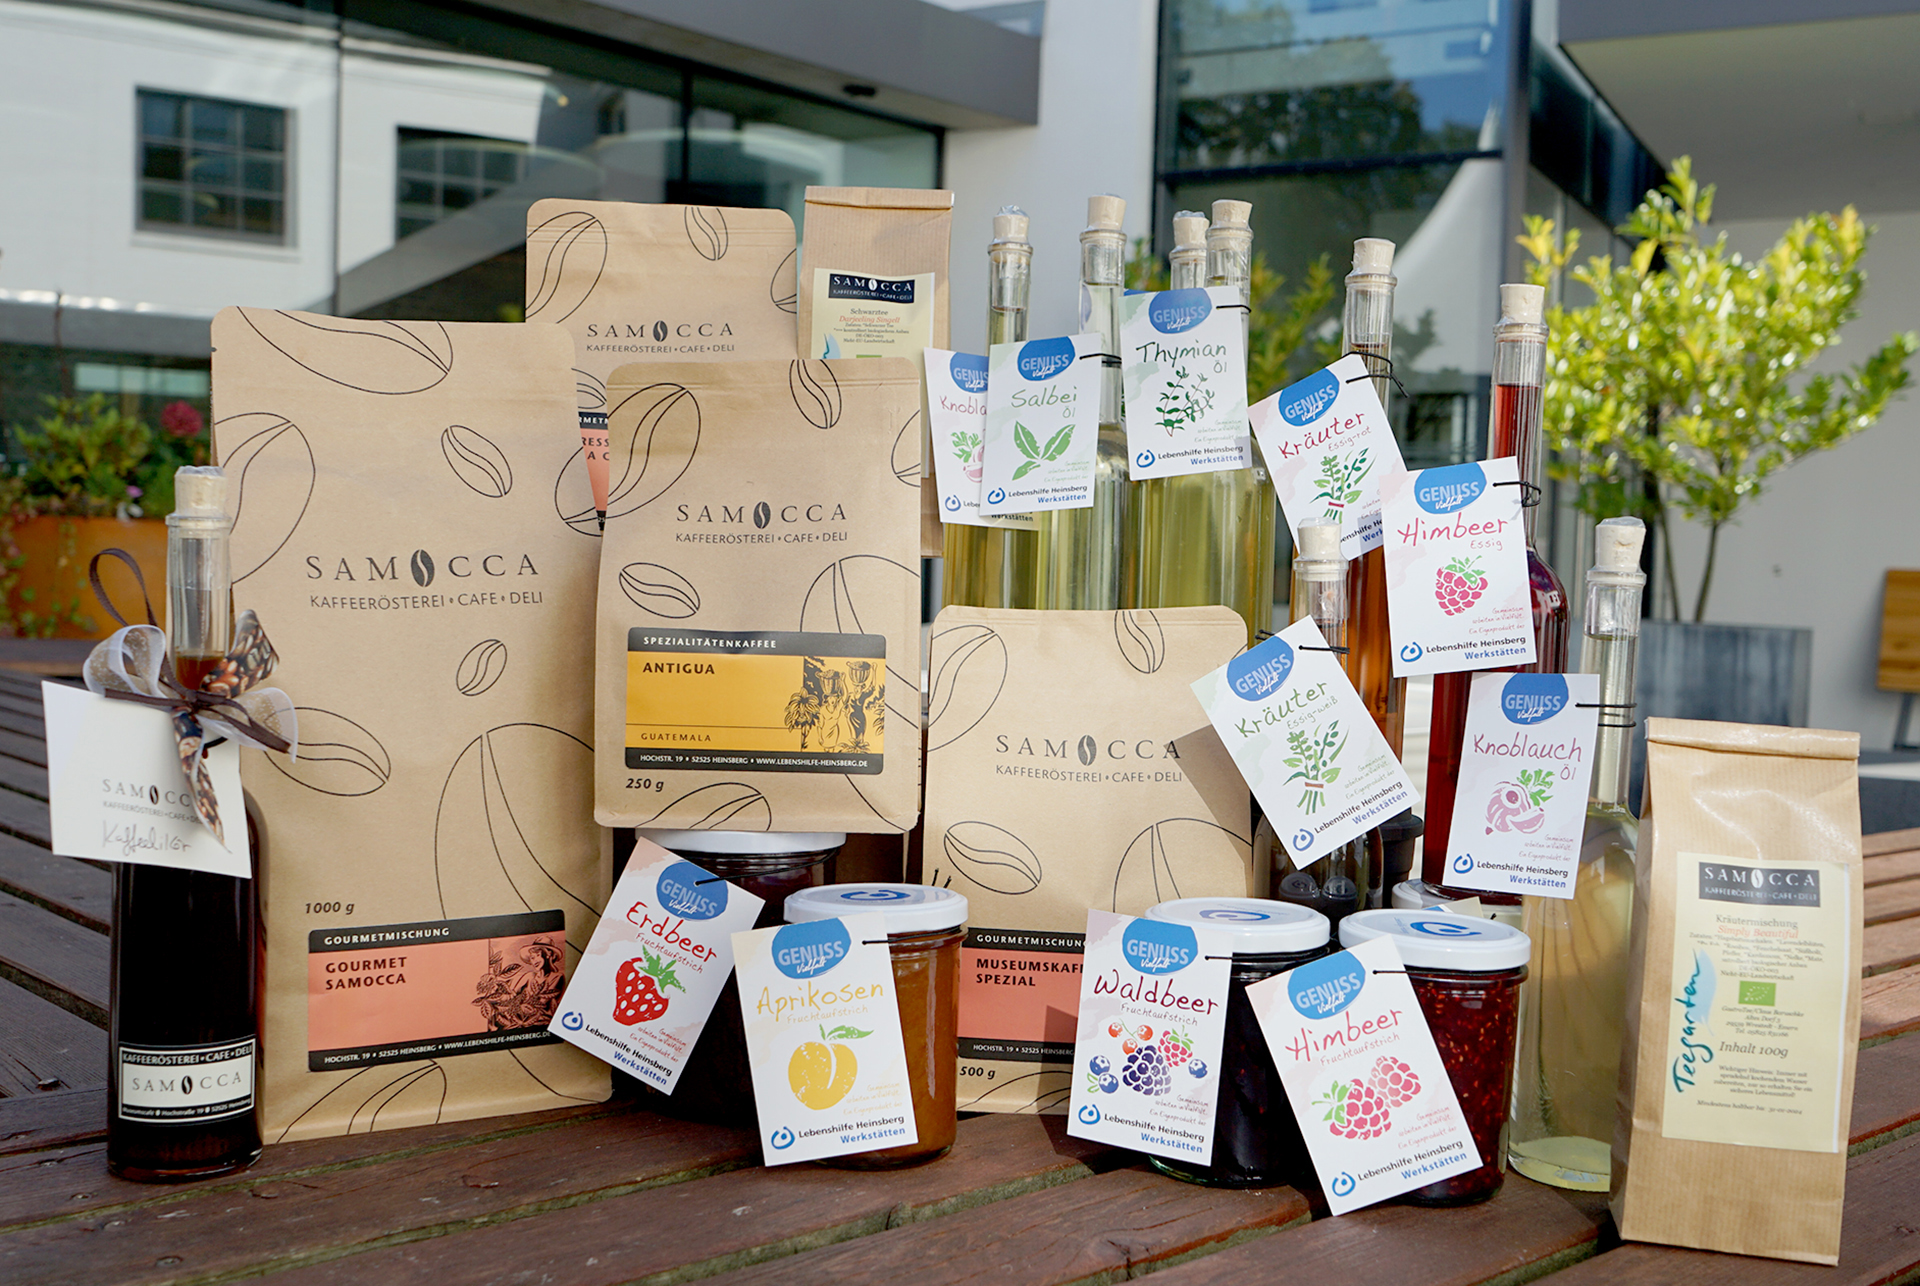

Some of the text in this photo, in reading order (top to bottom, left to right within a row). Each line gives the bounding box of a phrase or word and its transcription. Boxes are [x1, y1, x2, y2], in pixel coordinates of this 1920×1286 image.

[850, 308, 888, 316] Schwarztee
[1153, 306, 1206, 325] GENUSS
[586, 344, 735, 354] KAFFEERÖSTEREI CAFE DELI
[1136, 339, 1227, 368] Thymian
[1021, 354, 1069, 372] GENUSS
[1213, 362, 1228, 378] Öl
[953, 368, 987, 383] GENUS
[1011, 385, 1077, 408] Salbei
[1284, 384, 1337, 420] GENUSS
[1062, 407, 1076, 419] Öl
[1277, 412, 1366, 458] Kräuter
[1158, 445, 1244, 463] Lebenshilfe Heinsberg
[1190, 454, 1244, 467] Werkstätten
[1008, 485, 1088, 499] Lebenshilfe Heinsberg
[1037, 494, 1087, 504] Werkstätten
[1419, 481, 1480, 503] GENUSS
[676, 532, 848, 544] KAFFEERÖSTEREI CAFE DELI
[1397, 512, 1508, 547] Himbeer
[1470, 539, 1503, 552] Essig
[310, 591, 544, 611] KAFFEERÖSTEREI CAFE DELI
[643, 635, 777, 650] SPEZIALITÄTENKAFFEE
[1426, 636, 1527, 654] Lebenshilfe Heinsberg
[1464, 646, 1527, 660] Werkstätten
[642, 662, 716, 676] ANTIGUA
[1235, 653, 1292, 695] GENUSS
[1234, 682, 1328, 738] Kräuter
[1505, 694, 1562, 712] GENUSS
[641, 732, 712, 743] GUATEMALA
[1474, 731, 1583, 763] Knoblauch
[640, 754, 868, 769] HOCHSTR. 19 52525 HEINSBERG WWW.LEBENSHILFE-HEINSBERG.DE
[996, 764, 1182, 783] KAFFEERÖSTEREI CAFE DELI
[1560, 763, 1576, 781] Öl
[102, 779, 190, 807] SAMOCC
[626, 778, 664, 793] 250 g
[1314, 781, 1404, 835] Lebenshilfe Heinsberg
[1351, 790, 1409, 826] Werkstätten
[1477, 861, 1569, 879] Lebenshilfe Heinsberg
[1509, 875, 1567, 889] Werkstätten
[660, 878, 718, 918] GENUSS
[1798, 892, 1817, 902] DELI
[305, 902, 355, 915] 1000 g
[1715, 914, 1799, 930] Kräutermischung
[323, 927, 451, 946] GOURMETMISCHUNG
[626, 901, 718, 963] Erdbeer
[1717, 925, 1751, 938] Simply
[1753, 928, 1799, 940] Beautiful
[635, 932, 704, 975] Fruchtaufstrich
[777, 941, 845, 967] GENUSS
[1126, 938, 1190, 965] GENUSS
[325, 956, 408, 975] GOURMET
[325, 973, 407, 992] SAMOCCA
[976, 973, 1036, 987] SPEZIAL
[1094, 968, 1220, 1016] Waldbeer
[1294, 972, 1362, 1009] GENUSS
[756, 980, 884, 1022] Aprikosen
[786, 1004, 869, 1025] Fruchtaufstrich
[1120, 1002, 1199, 1027] Fruchtaufstrich
[1672, 947, 1714, 1093] Teegarten
[1284, 1009, 1404, 1062] Himbeer
[205, 1052, 231, 1063] CAFE
[235, 1044, 253, 1058] DELI
[361, 1053, 371, 1062] 19
[378, 1050, 399, 1059] 52525
[400, 1044, 437, 1056] HEINSBERG
[585, 1023, 673, 1077] Lebenshilfe Heinsberg
[973, 1043, 1004, 1053] HOCHSTR.
[1320, 1033, 1401, 1067] Fruchtaufstrich
[1719, 1041, 1788, 1059] Inhalt 100g
[613, 1051, 668, 1086] Werkstätten
[960, 1065, 996, 1080] 500 g
[798, 1115, 905, 1138] Lebenshilfe Heinsberg
[840, 1126, 906, 1145] Werkstätten
[1104, 1113, 1206, 1143] Lebenshilfe Heinsberg
[1140, 1132, 1204, 1154] Werkstätten
[1357, 1139, 1464, 1182] Lebenshilfe Heinsberg
[1401, 1152, 1469, 1181] Werkstätten
